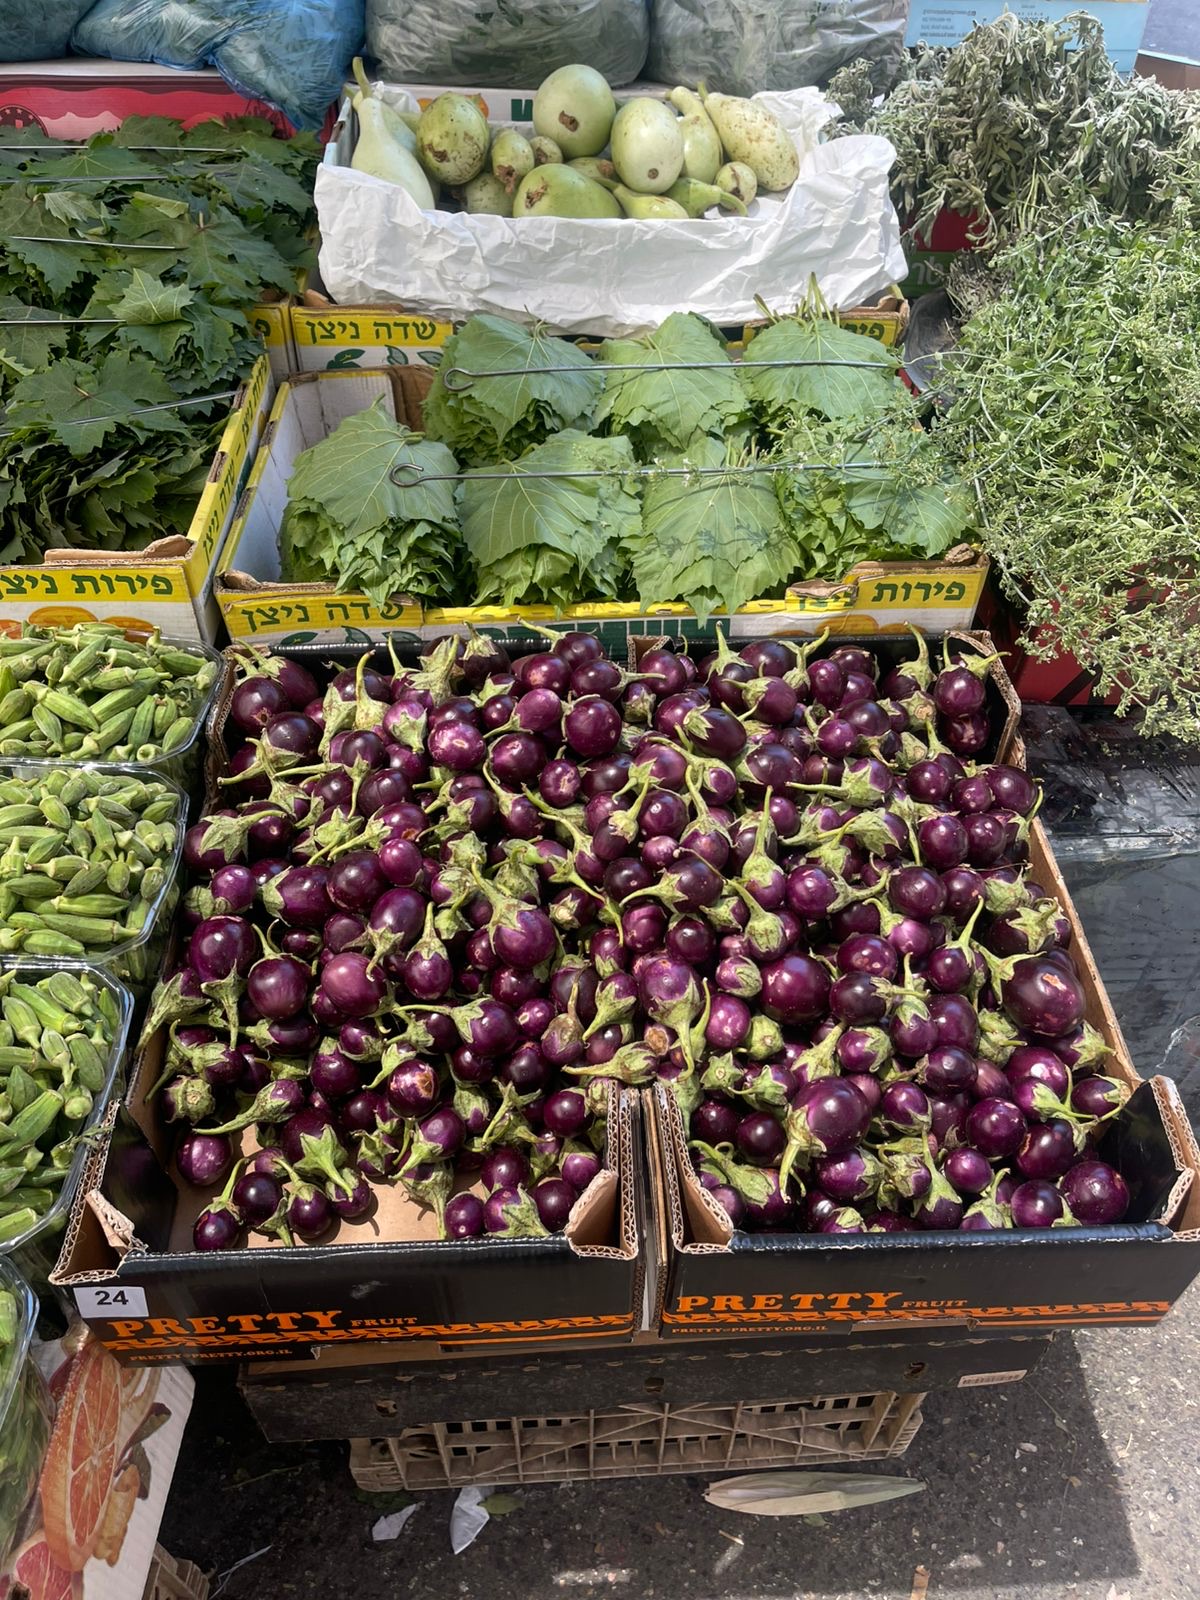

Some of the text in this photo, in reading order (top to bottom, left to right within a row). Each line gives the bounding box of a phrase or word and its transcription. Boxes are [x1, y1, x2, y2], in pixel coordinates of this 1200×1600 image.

[305, 321, 436, 344] שדה ניצן
[0, 574, 173, 599] פירות ניצ
[871, 581, 966, 602] פירות
[241, 601, 404, 632] שדה ניצן
[94, 1290, 129, 1305] 24
[676, 1292, 968, 1312] PRETTY FRUIT
[107, 1310, 418, 1337] PRETTY FRUIT
